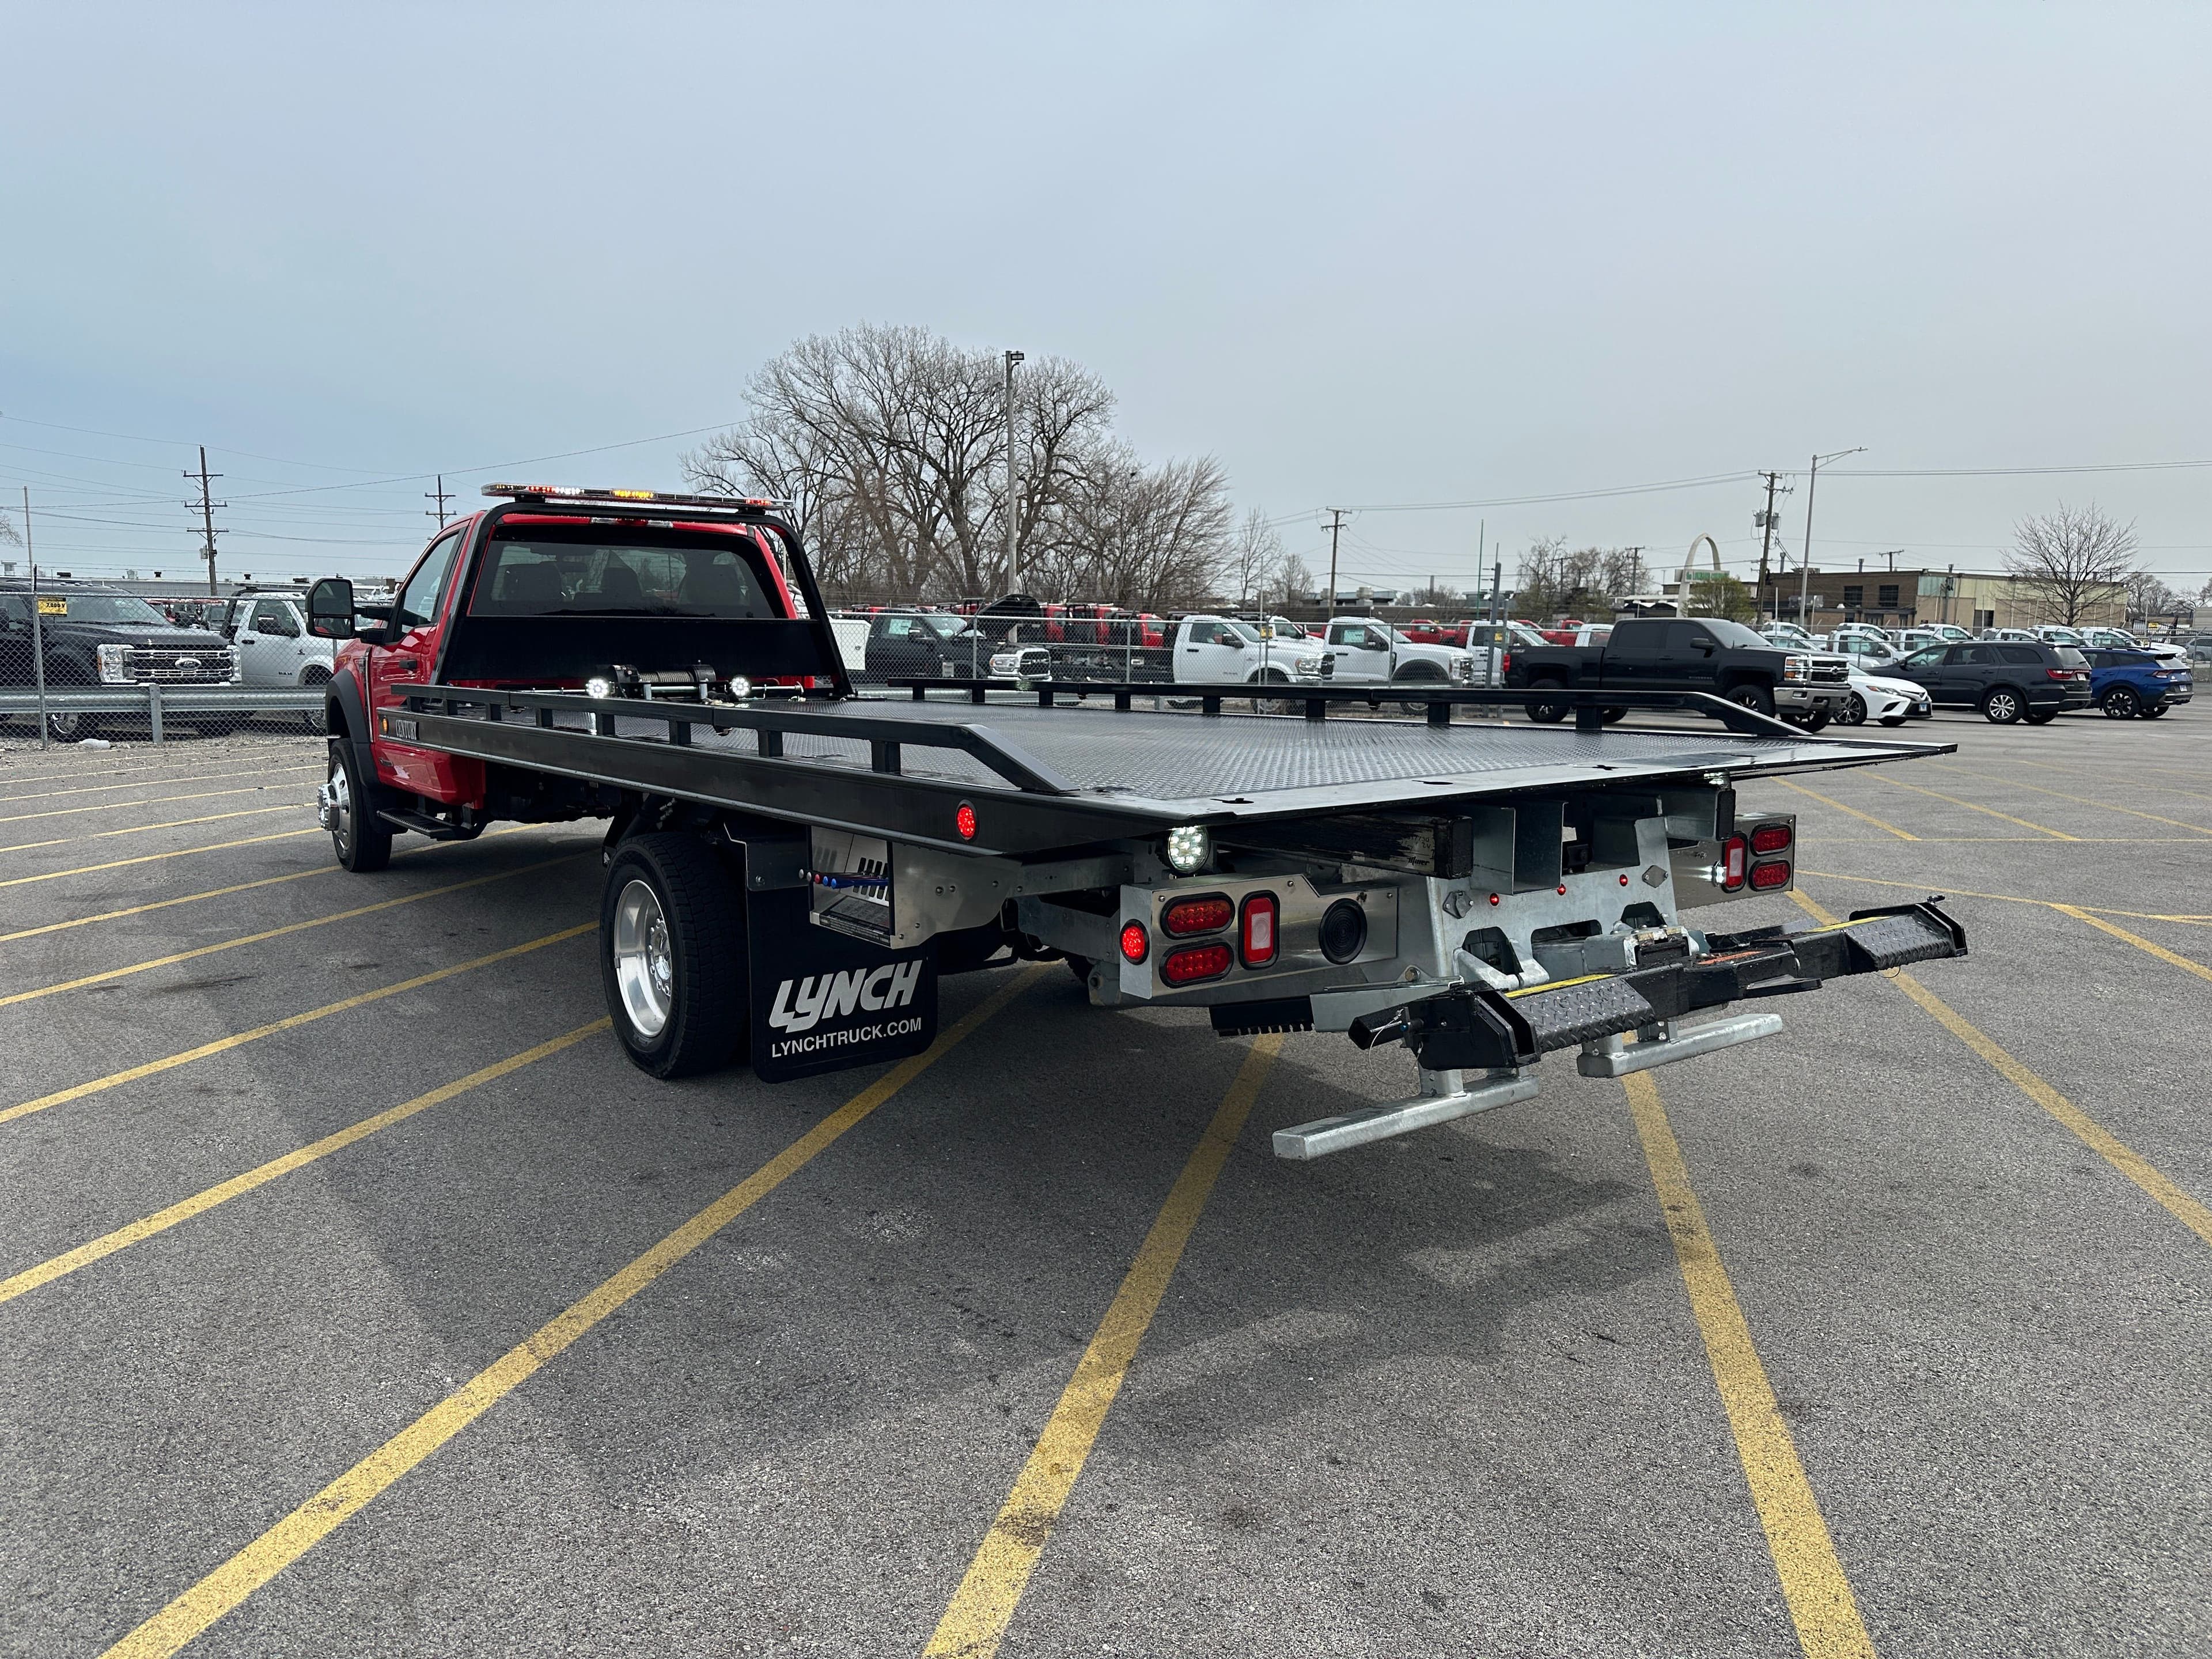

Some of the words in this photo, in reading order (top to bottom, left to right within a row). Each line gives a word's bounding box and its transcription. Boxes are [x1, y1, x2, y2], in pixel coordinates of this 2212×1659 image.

[395, 719, 416, 740] CENTURY
[769, 960, 922, 1033] LYNCH
[772, 1017, 921, 1058] LYNCHTRUCK.COM
